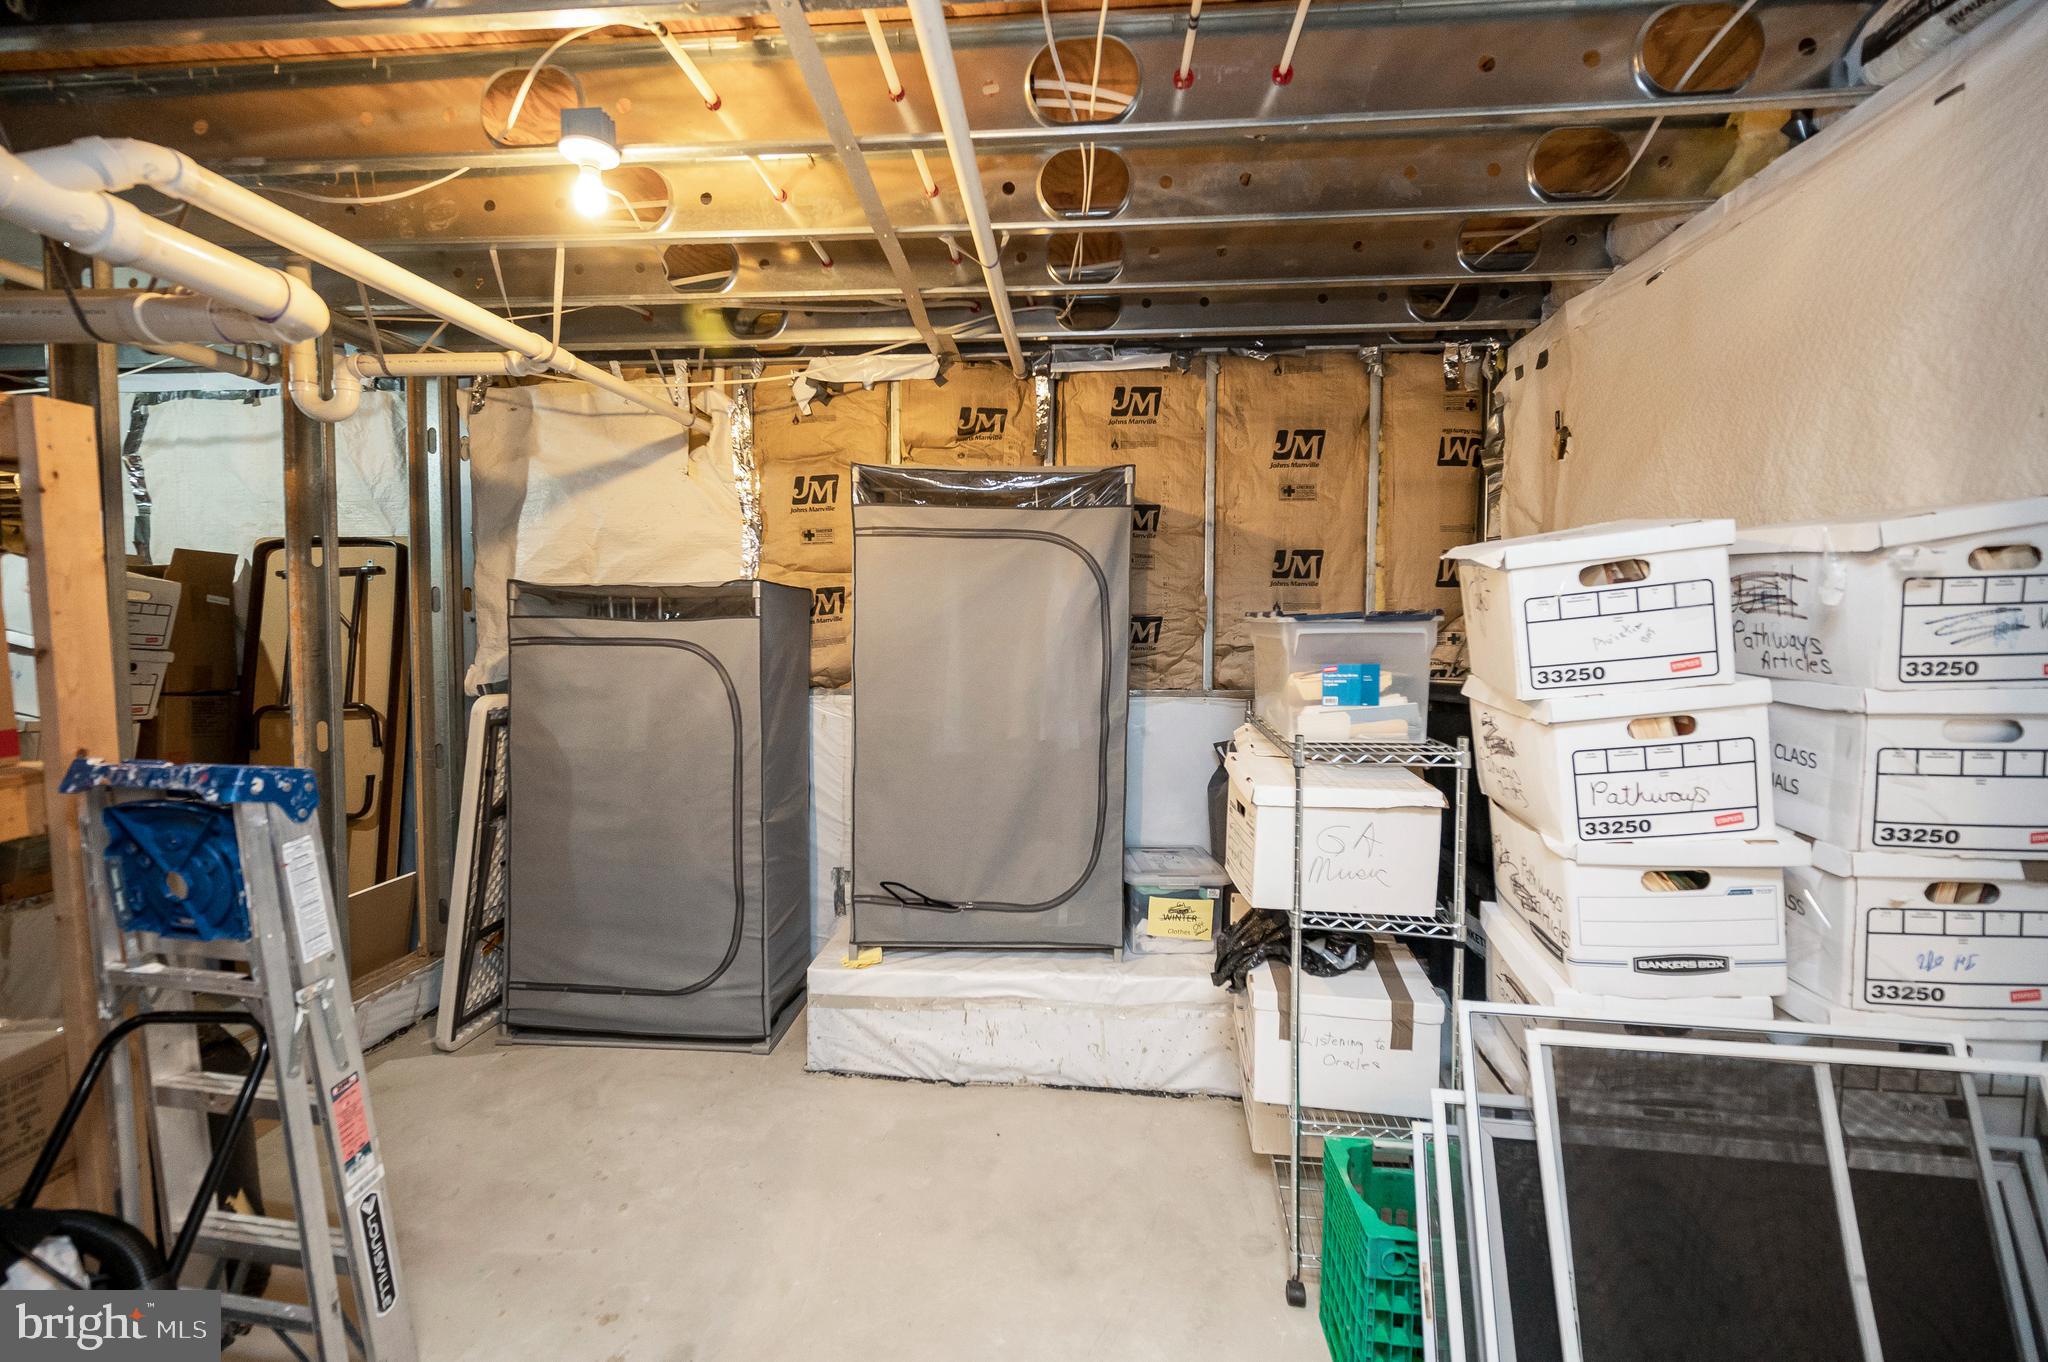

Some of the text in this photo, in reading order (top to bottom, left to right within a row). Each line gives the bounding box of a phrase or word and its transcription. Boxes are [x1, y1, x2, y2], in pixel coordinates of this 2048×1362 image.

[1111, 386, 1163, 417] JM
[957, 407, 1008, 437] JM
[1108, 418, 1127, 426] Johns
[1272, 429, 1327, 460] JM
[1269, 461, 1290, 469] Johns
[792, 474, 839, 505] JM
[790, 505, 836, 514] Johns Manville
[1133, 504, 1161, 532] M
[1272, 549, 1325, 579] JM
[813, 586, 846, 616] M
[1131, 616, 1163, 644] M
[1733, 619, 1823, 658] Pathways
[1537, 666, 1606, 684] 33250
[1761, 650, 1832, 674] Articles
[1905, 661, 1979, 677] 33250
[1774, 743, 1817, 769] CLASS
[1590, 781, 1711, 811] Pathways
[1585, 820, 1651, 835] 33250
[1880, 827, 1961, 844] 33250
[1167, 928, 1192, 936] Clothes
[1638, 959, 1726, 970] BANKERS BOX
[1871, 984, 1945, 1002] 33250
[1300, 1026, 1386, 1055] Listening to
[366, 1212, 393, 1311] LOUISVILLE
